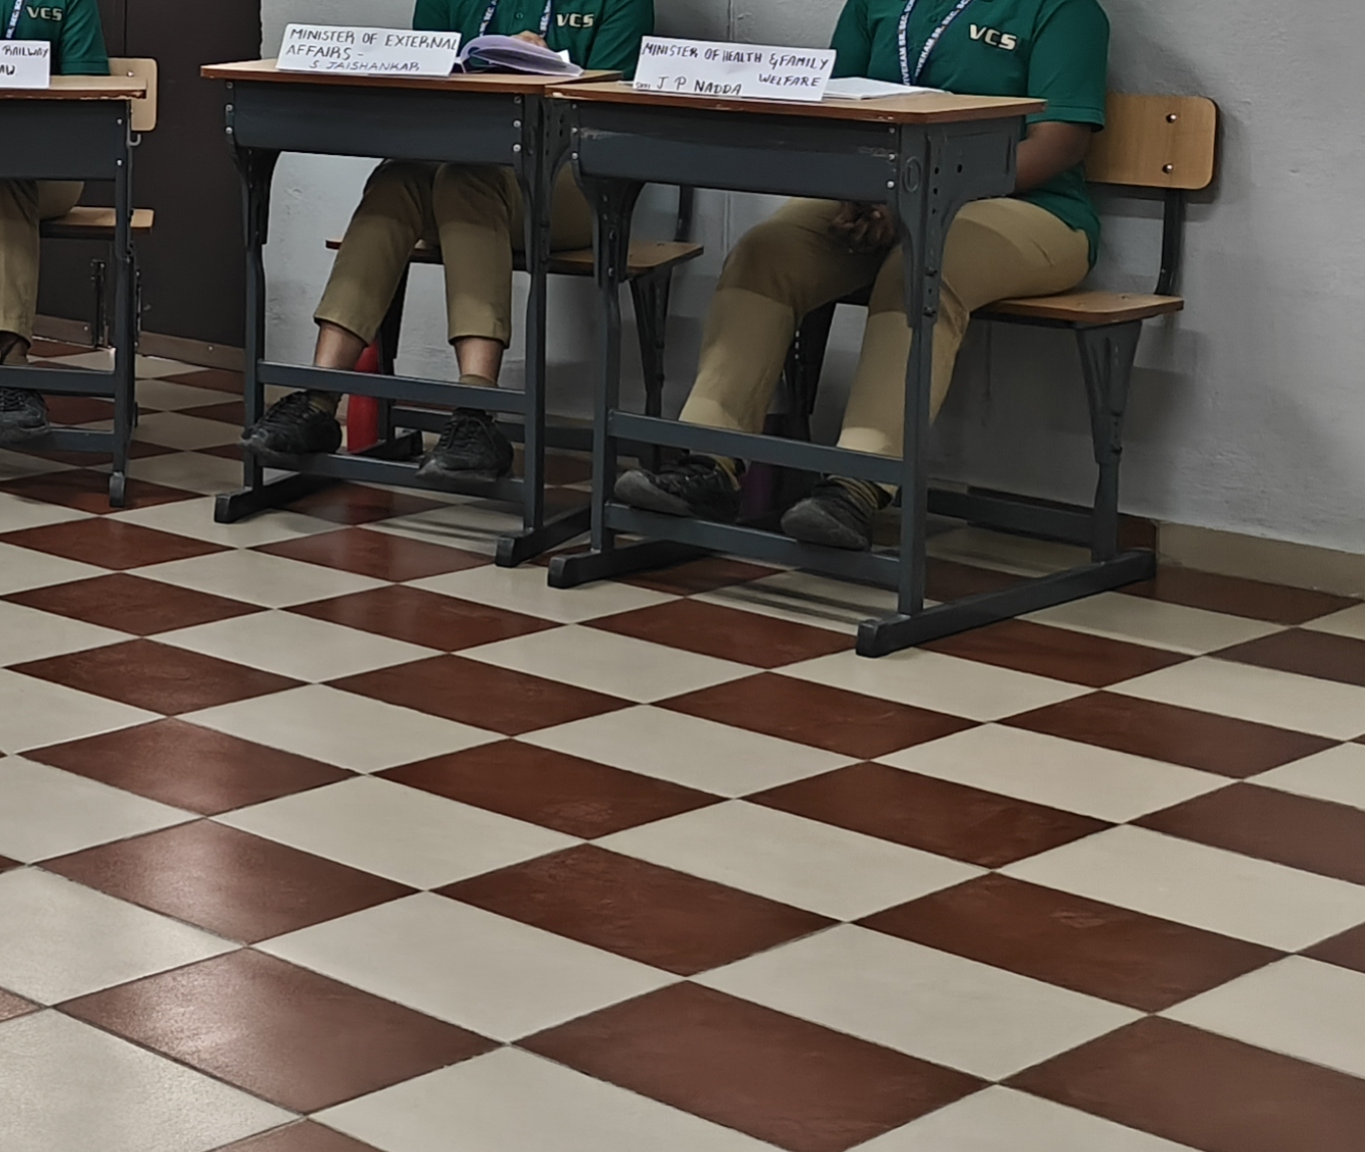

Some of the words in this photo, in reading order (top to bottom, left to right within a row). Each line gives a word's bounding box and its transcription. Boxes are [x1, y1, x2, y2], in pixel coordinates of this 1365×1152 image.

[26, 6, 62, 21] VCS
[557, 13, 594, 27] VCS
[289, 29, 355, 44] MINISTER
[362, 32, 378, 46] OF
[384, 34, 457, 50] EXTERNAL
[970, 24, 1017, 50] VCS
[2, 44, 48, 58] RAILWAY
[286, 45, 352, 60] AFFAIRS
[642, 42, 698, 59] MINISTER
[704, 49, 719, 60] OF
[722, 50, 762, 64] HEALTH
[309, 60, 319, 69] S
[326, 61, 420, 71] JAISHANKAR
[657, 76, 668, 90] J
[674, 77, 686, 91] P
[695, 80, 742, 95] NADDA
[759, 73, 821, 88] WELFARE
